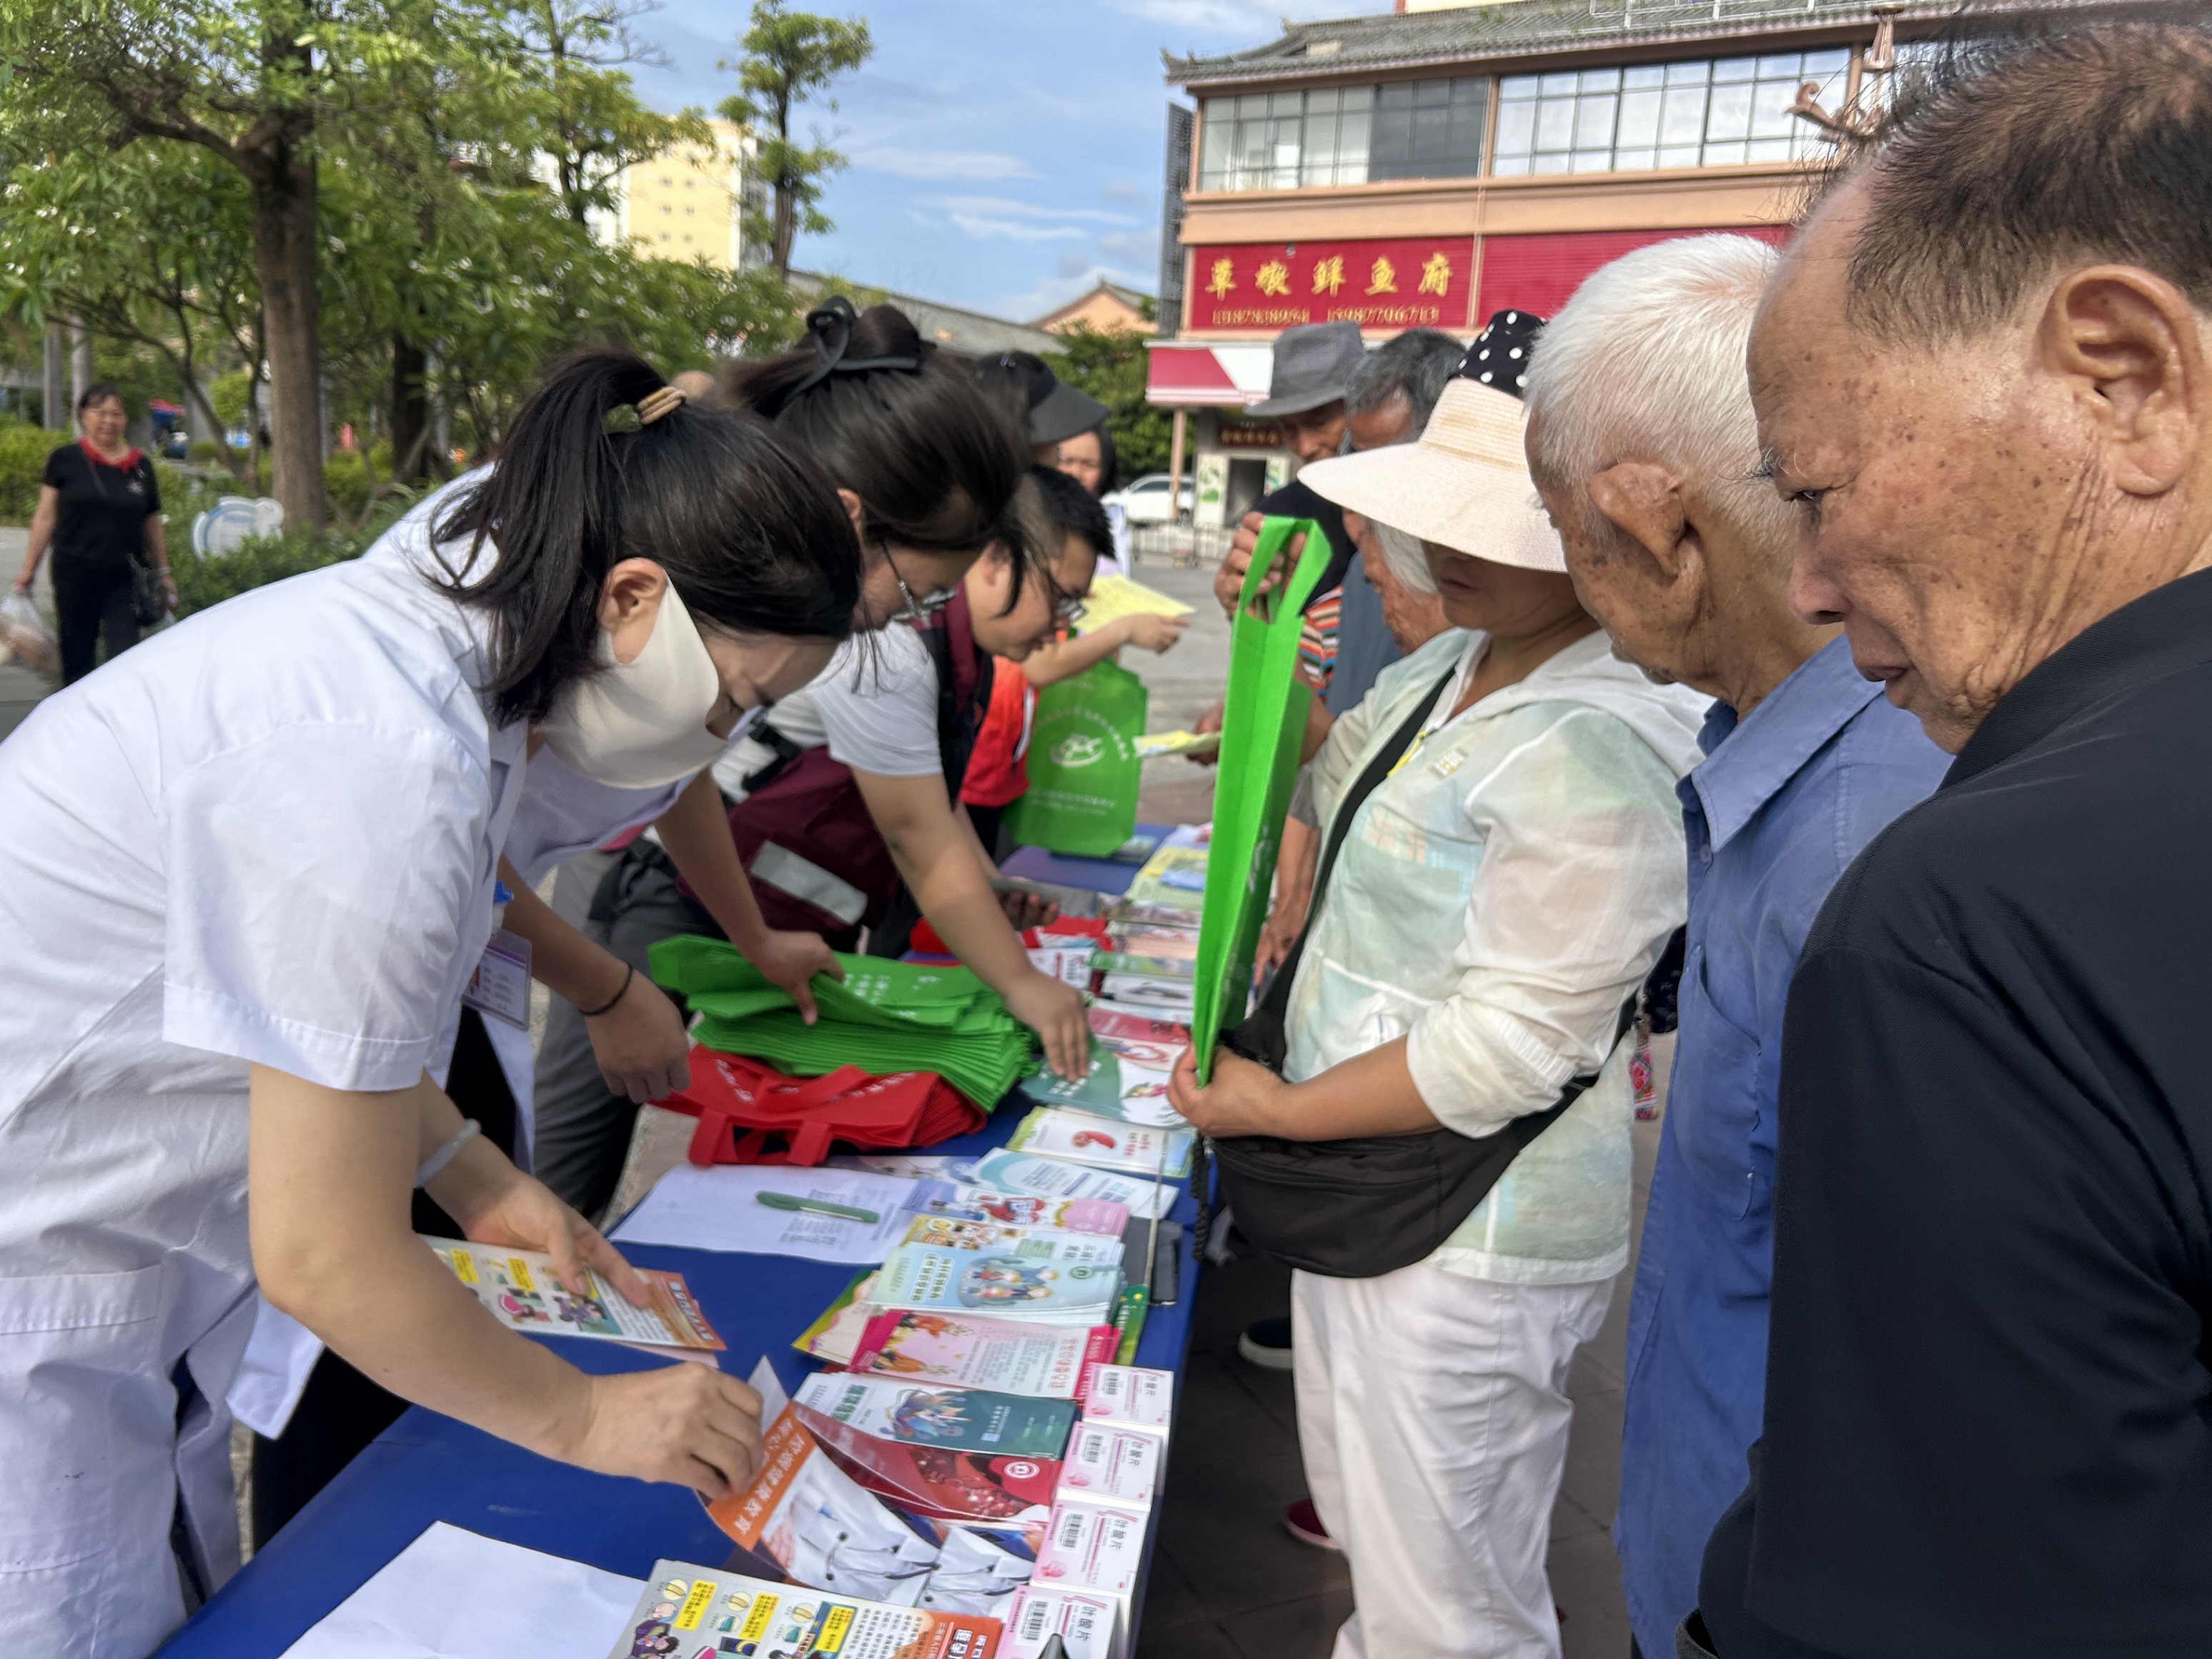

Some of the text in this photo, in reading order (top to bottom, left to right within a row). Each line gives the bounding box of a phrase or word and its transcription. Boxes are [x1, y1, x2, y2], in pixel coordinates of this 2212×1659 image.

[1128, 1440, 1145, 1467] 叶酸片
[1109, 1519, 1129, 1550] 叶酸片
[1075, 1605, 1097, 1642] 叶酸片
